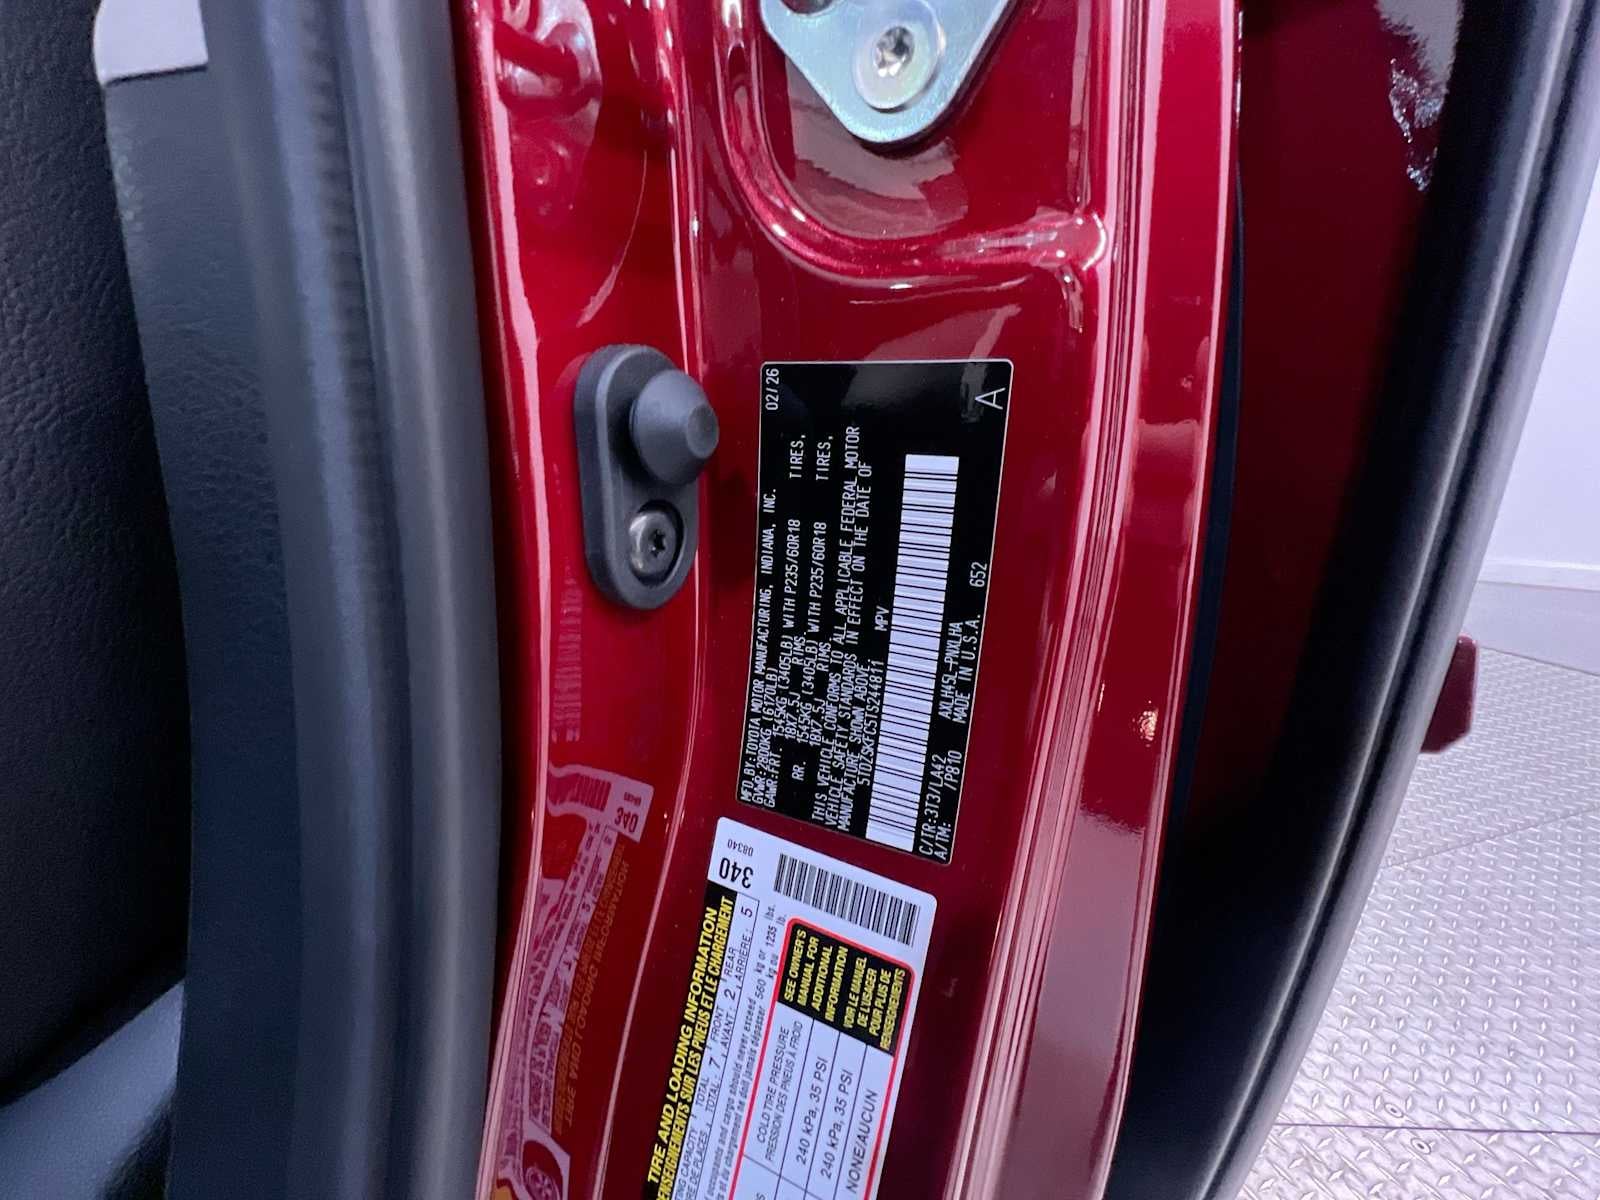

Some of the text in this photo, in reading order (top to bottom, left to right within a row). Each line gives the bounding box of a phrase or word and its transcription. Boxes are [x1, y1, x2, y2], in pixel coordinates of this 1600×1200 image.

[765, 368, 779, 410] 02/26
[974, 387, 1006, 409] A
[789, 433, 805, 478] TIRES,
[763, 487, 775, 512] INC.
[760, 522, 776, 574] INDIANA,
[784, 518, 800, 594] P235/60R18
[754, 583, 772, 674] MANUFACTURING,
[782, 597, 795, 629] WITH
[791, 434, 833, 781] RR. 1545KG (3405LB) WITH P235/60R18 TIRES,
[811, 426, 860, 821] THIS VEHICLE CONFORMS TO ALL APPLICABLE FEDERAL MOTOR
[777, 634, 793, 689] (3405LB)
[824, 460, 872, 827] VEHICLE SAFETY STANDARDS IN EFFECT ON THE DATE OF
[952, 561, 987, 724] MADE IN U.S.A. 652
[761, 666, 777, 721] (6170LB)
[784, 629, 806, 741] 18X7.5J RIMS.
[808, 635, 831, 747] 18X7.5J RIMS.
[937, 620, 964, 719] AXLH45L-PNXLHA
[751, 678, 764, 713] MOTOR
[772, 695, 787, 738] 1545KG
[856, 605, 890, 786] 5TDZSKFC5TS244811 MPV
[837, 656, 871, 832] MANUFACTURE SHOWN ABOVE.
[934, 820, 952, 860] A/TM:
[716, 857, 755, 888] 340
[706, 895, 734, 976] CHARGEMENT
[740, 905, 753, 917] 5
[765, 925, 777, 947] 1235
[702, 975, 718, 992] LE
[723, 946, 737, 977] REAR
[753, 962, 765, 973] kg
[783, 929, 807, 1002] SEE OWNER'S
[796, 936, 819, 1005] MANUAL FOR
[810, 943, 833, 1011] ADDITIONAL
[824, 945, 848, 1021] INFORMATION
[699, 989, 715, 1009] ET
[722, 988, 736, 1000] 2
[754, 978, 766, 999] 560
[842, 955, 867, 1028] VOIR LE MANUEL
[868, 968, 891, 1036] POUR PLUS DE
[878, 967, 906, 1050] RENSEIGNEMENTS
[647, 906, 718, 1183] TIRE AND LOADING INFORMATION
[690, 1008, 711, 1050] PNEUS
[709, 1005, 724, 1041] FRONT
[789, 1020, 803, 1049] FROID
[856, 1012, 869, 1027] DE
[684, 1049, 702, 1075] LES
[708, 1056, 722, 1068] 7
[755, 1025, 790, 1143] COLD TIRE PRESSURE
[779, 1058, 795, 1090] PNEUS
[679, 1074, 696, 1102] SUR
[774, 1093, 788, 1112] DES
[795, 1056, 828, 1165] 240 kPa, 35 PSI
[679, 1127, 698, 1177] CAPACITY
[695, 1075, 709, 1106] TOTAL
[763, 1113, 783, 1162] PRESSION
[820, 1069, 854, 1179] 240 kPa, 35 PSI
[845, 1088, 879, 1194] NONE/AUCUN
[692, 1130, 708, 1169] PLACES
